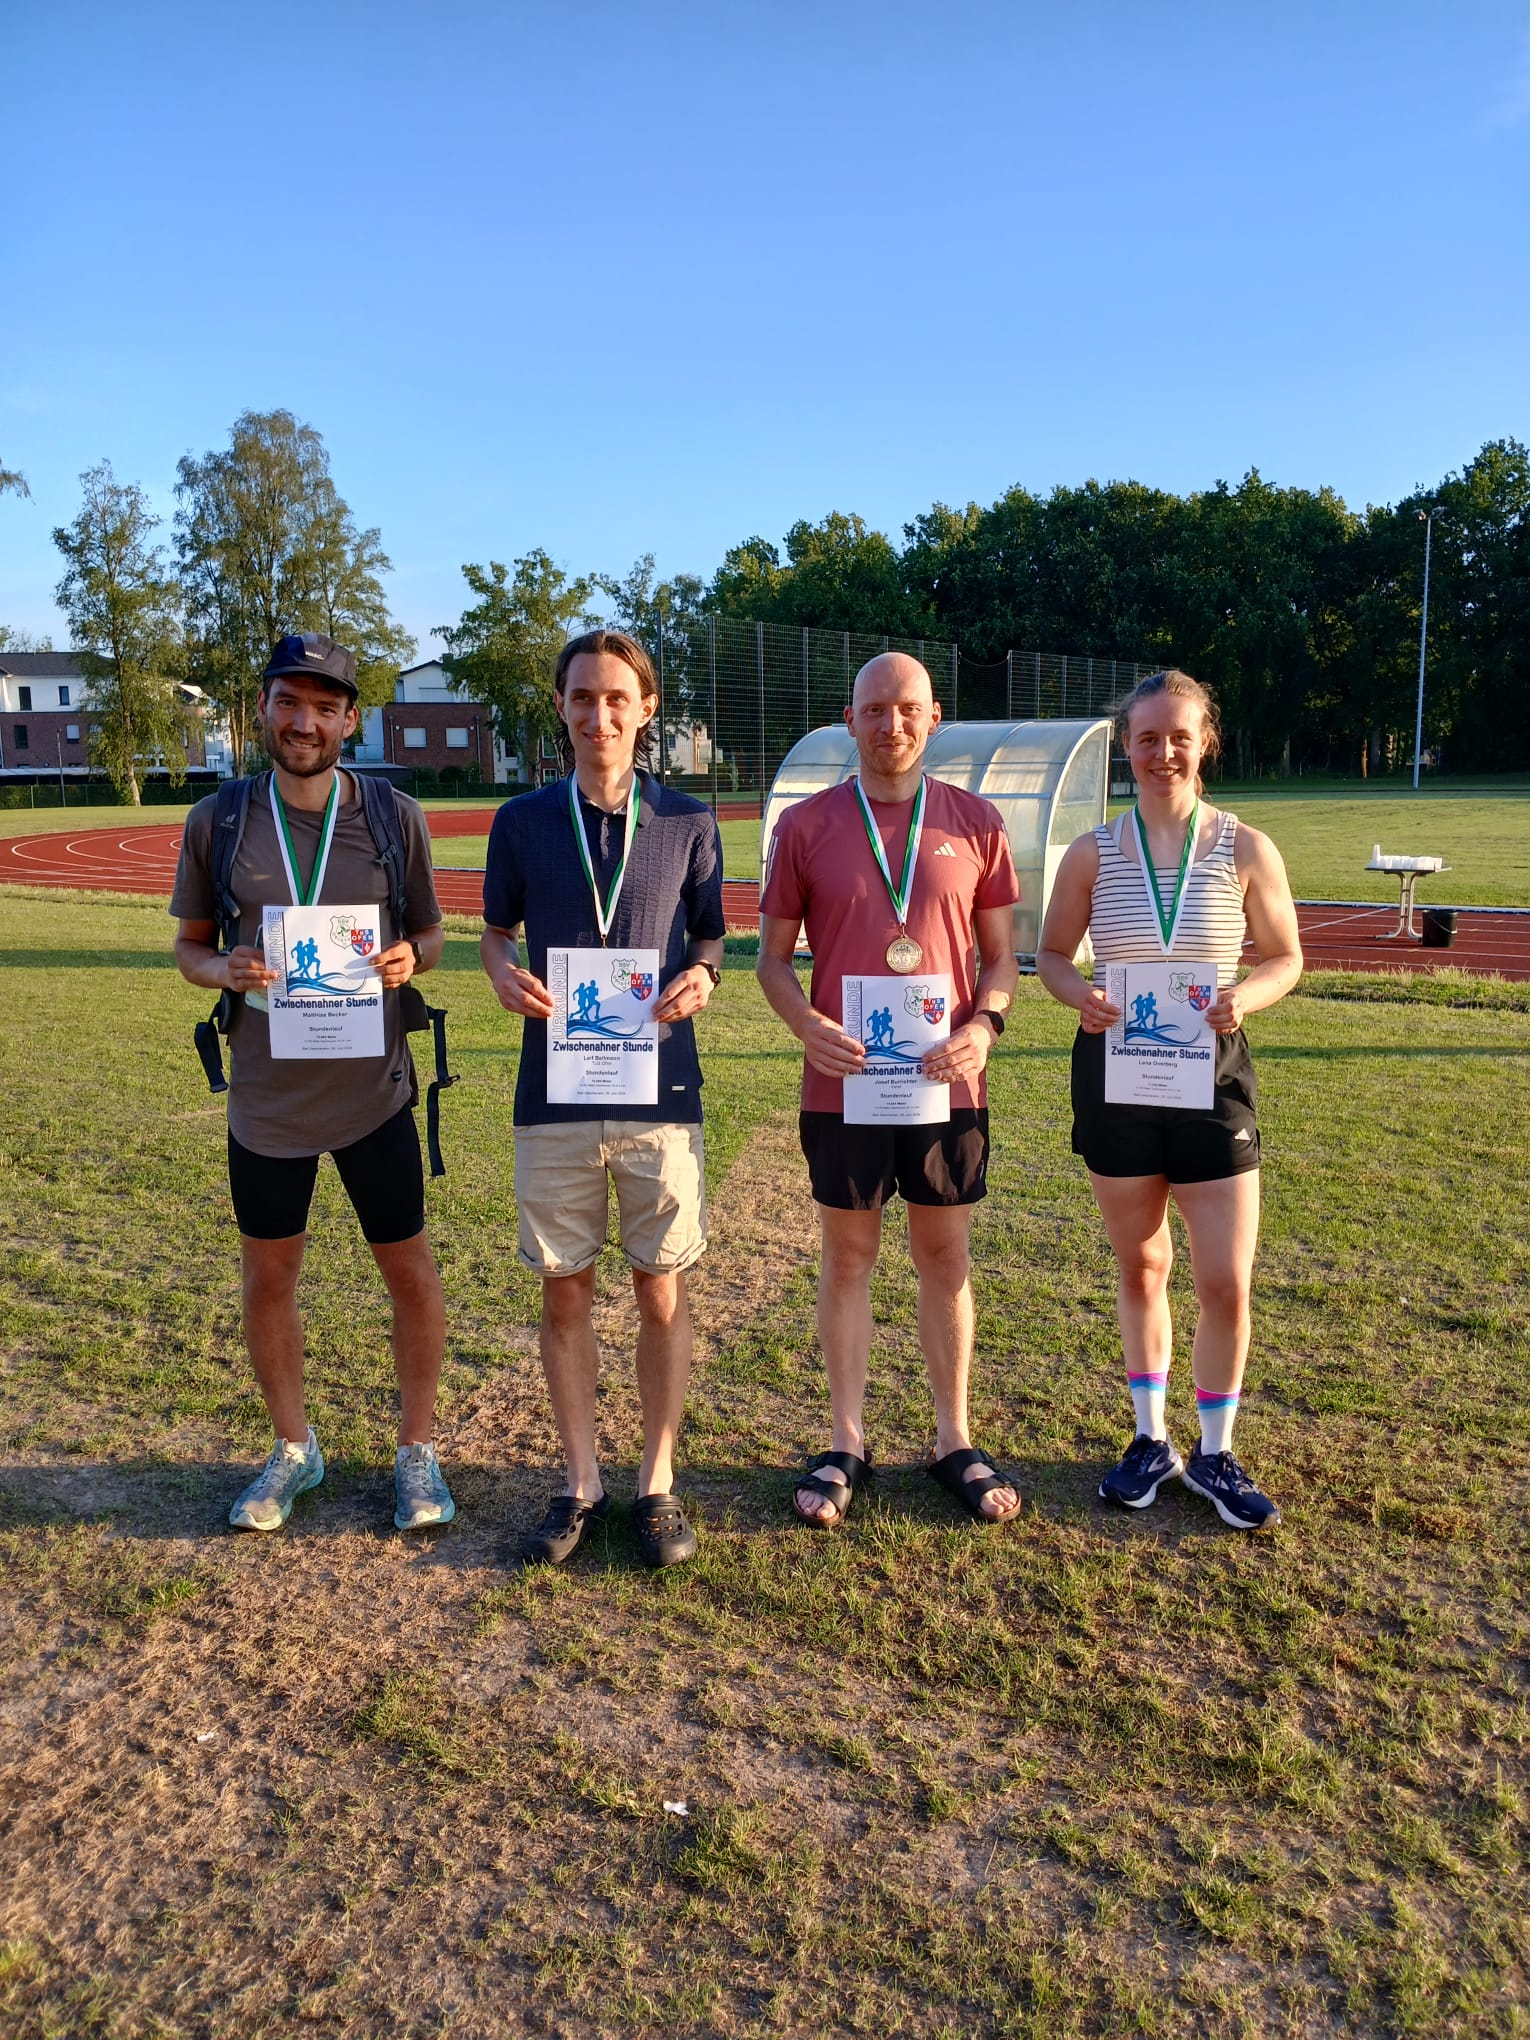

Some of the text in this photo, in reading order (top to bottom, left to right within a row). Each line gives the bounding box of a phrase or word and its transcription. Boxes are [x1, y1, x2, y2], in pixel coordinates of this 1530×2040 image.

[274, 996, 378, 1009] Zwischenahner Stunde
[552, 953, 566, 1040] URKUNDE
[553, 1041, 653, 1052] Zwischenahner Stunde
[1111, 1046, 1210, 1060] Zwischenahner Stunde
